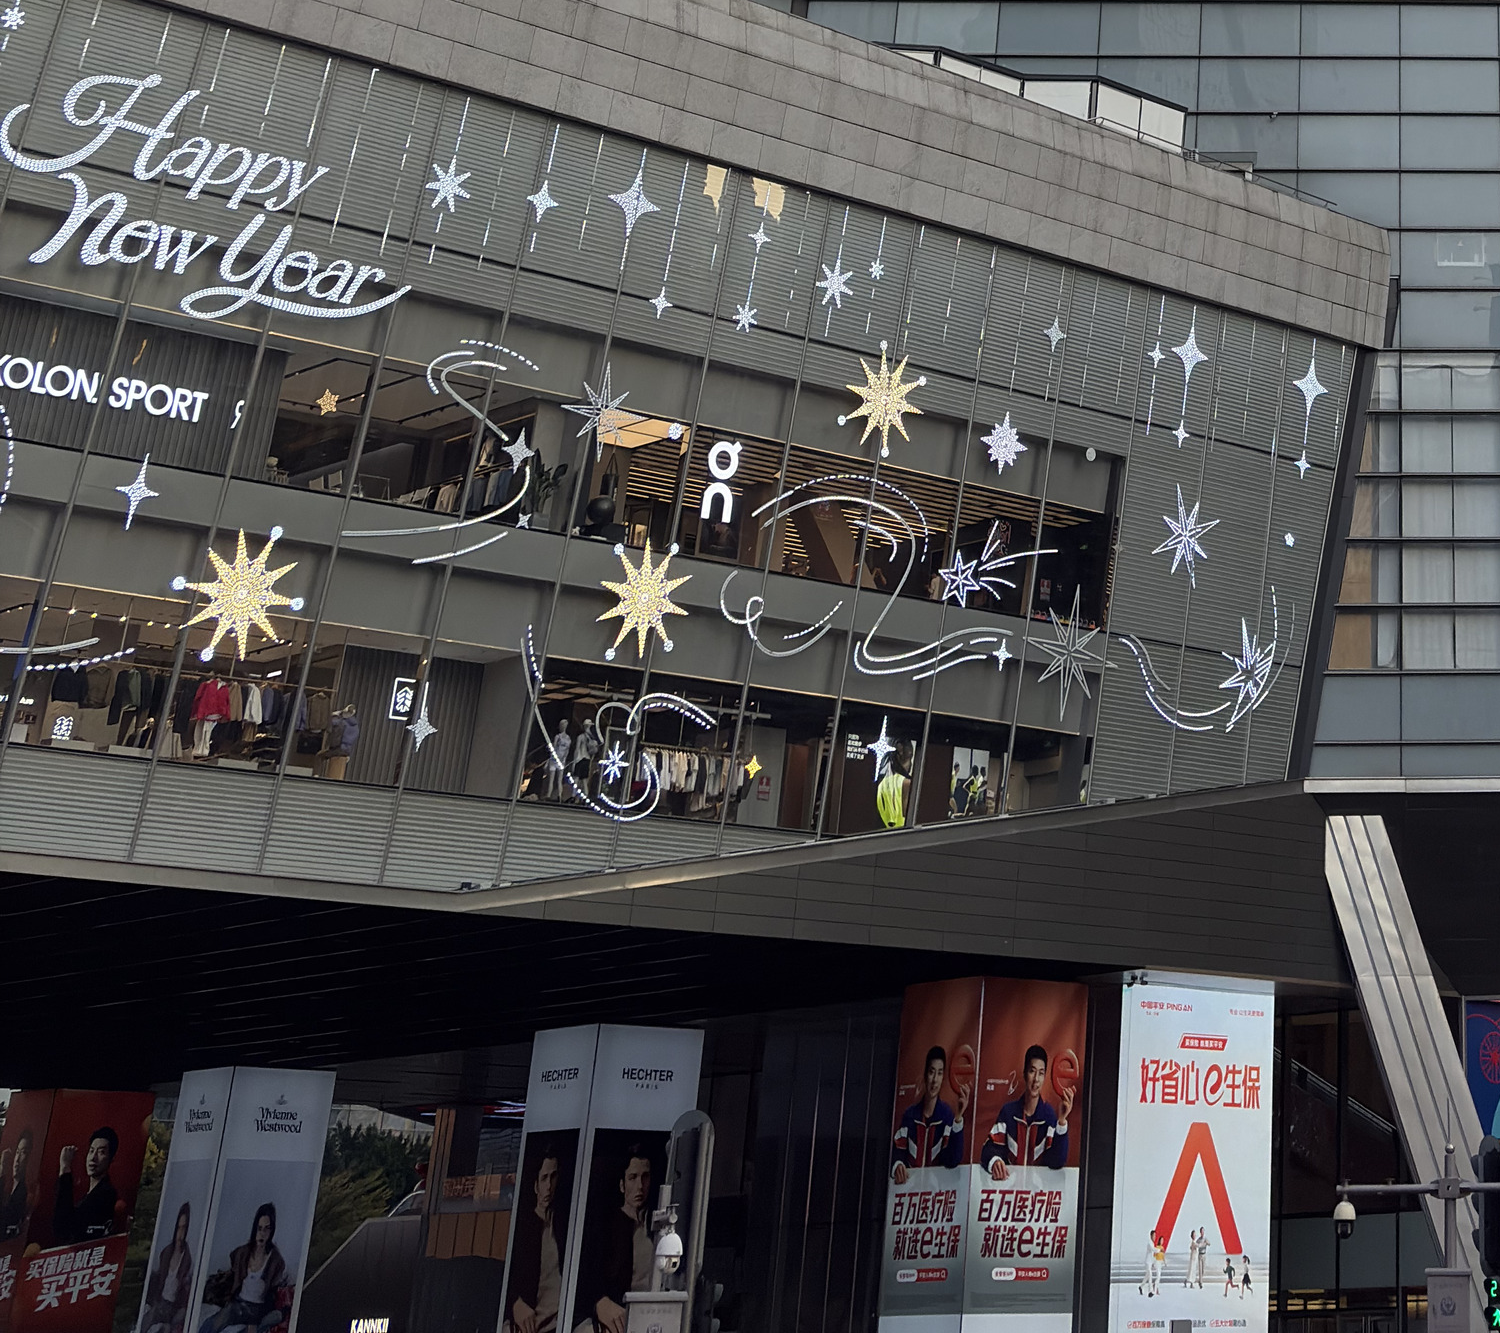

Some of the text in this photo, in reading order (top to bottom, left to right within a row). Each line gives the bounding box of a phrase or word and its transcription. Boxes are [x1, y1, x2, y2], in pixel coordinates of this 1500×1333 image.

[1, 73, 329, 211] Happy
[28, 173, 412, 318] New Year
[108, 376, 209, 423] SPORT
[541, 1067, 580, 1083] HECHTER
[622, 1067, 674, 1082] HECHTER
[254, 1118, 303, 1134] Westwood
[259, 1106, 298, 1121] Vivienne
[891, 1189, 957, 1226] 百万医疗险
[977, 1188, 1062, 1223] 百万医疗险
[979, 1225, 1069, 1260] 就选e生保
[25, 1246, 106, 1282] 买保险就是
[34, 1263, 119, 1312] 买平安
